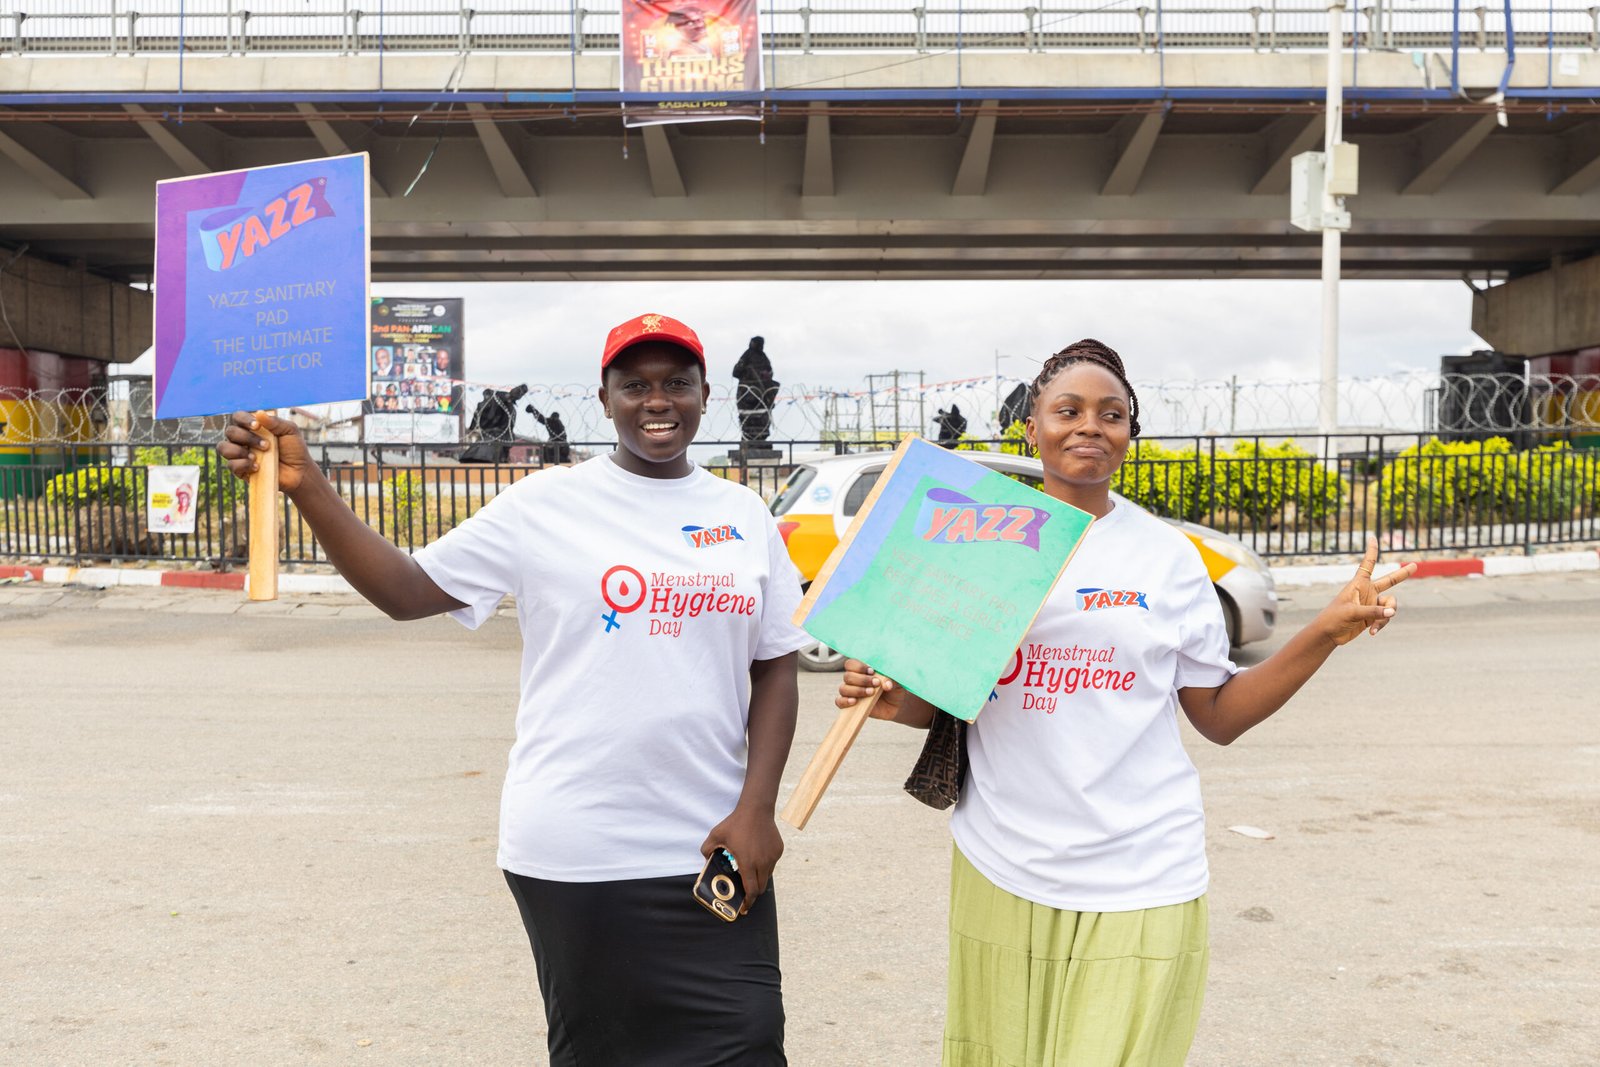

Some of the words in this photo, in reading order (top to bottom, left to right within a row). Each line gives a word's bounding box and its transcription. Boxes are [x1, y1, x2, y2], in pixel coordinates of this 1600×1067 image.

[217, 183, 316, 270] YAZZ
[208, 290, 249, 309] YAZZ
[254, 280, 336, 304] SANITARY
[256, 309, 288, 327] PAD
[373, 325, 389, 333] 2nd
[391, 325, 452, 333] PAN-AFRICAN
[212, 336, 245, 355] THE
[251, 327, 333, 351] ULTIMATE
[223, 353, 323, 377] PROTECTOR
[923, 507, 1034, 541] YAZZ
[691, 525, 734, 548] YAZZ
[650, 572, 735, 588] Menstrual
[649, 587, 756, 618] Hygiene
[1083, 591, 1139, 611] YAZZ
[649, 618, 683, 638] Day
[1027, 644, 1115, 663] Menstrual
[1023, 661, 1136, 694] Hygiene
[1022, 693, 1058, 714] Day
